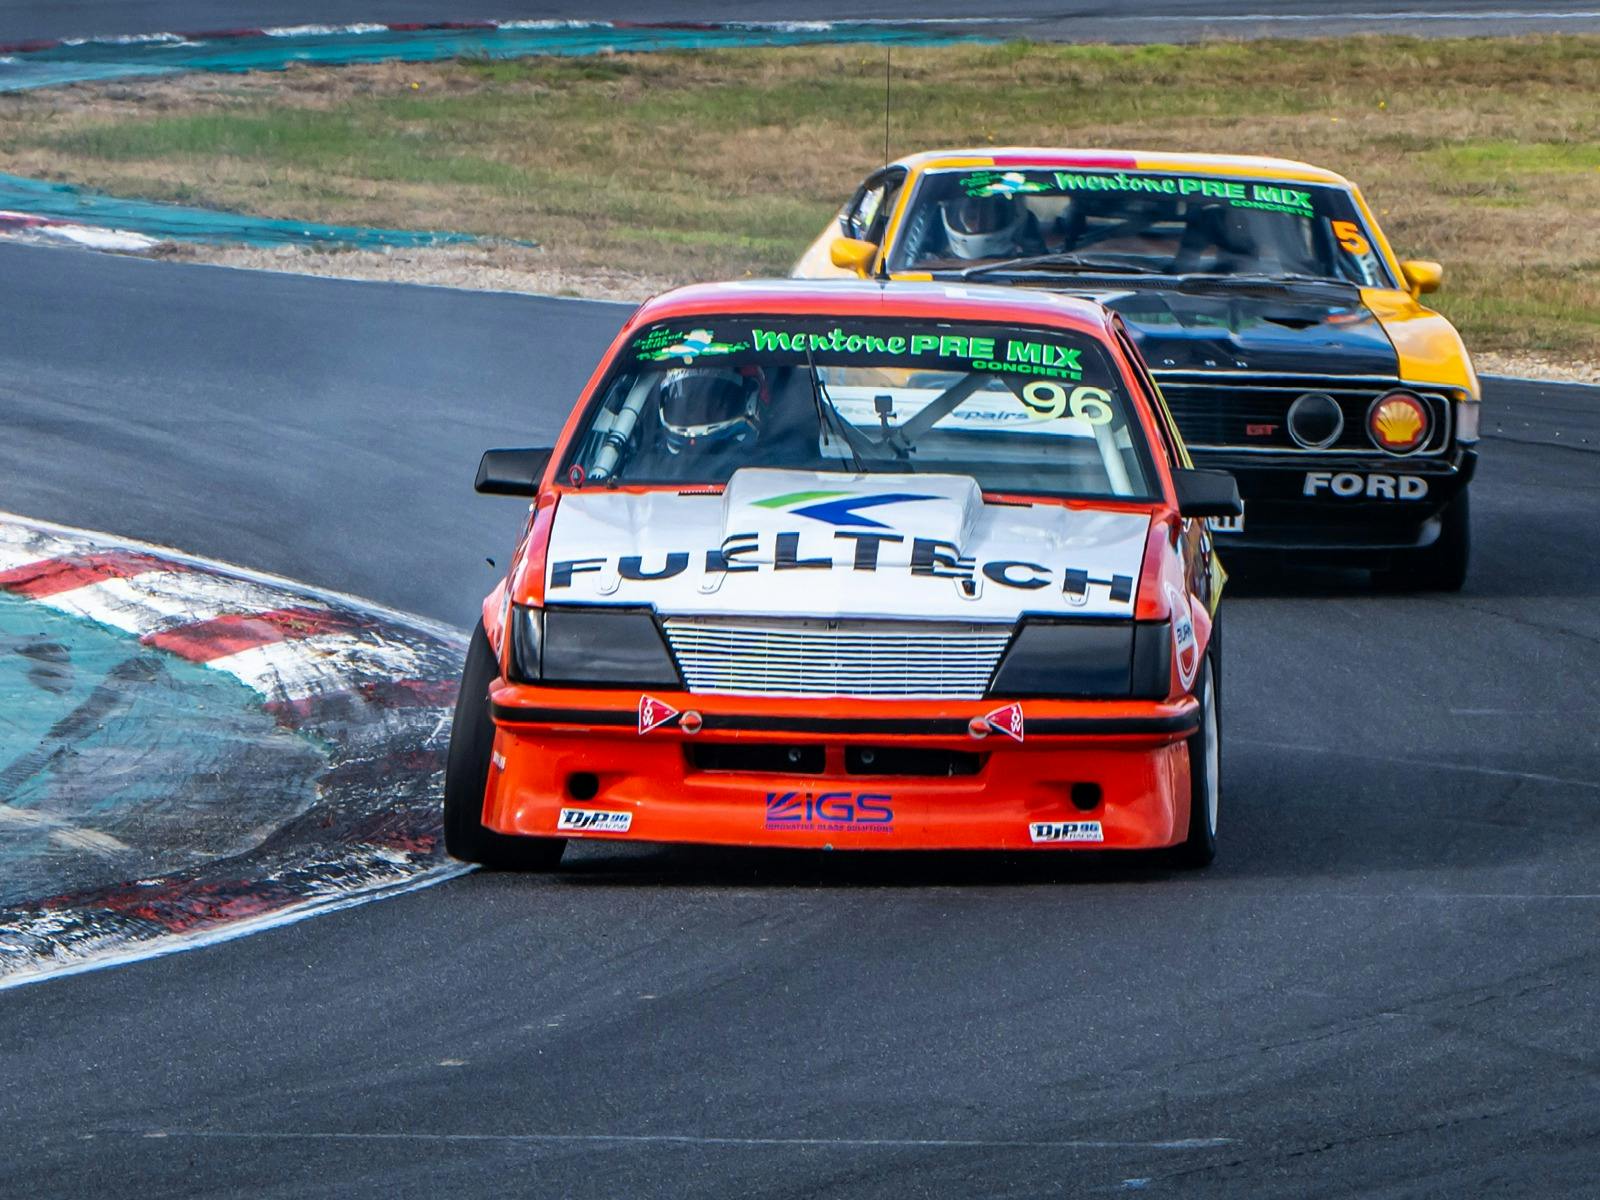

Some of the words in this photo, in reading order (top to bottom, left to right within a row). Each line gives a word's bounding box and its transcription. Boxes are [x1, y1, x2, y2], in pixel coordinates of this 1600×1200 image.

[1178, 177, 1246, 199] PRE
[1254, 184, 1314, 210] MIX
[1230, 198, 1314, 219] CONCRETE
[1331, 220, 1370, 255] 5
[910, 334, 995, 360] PRE
[1006, 339, 1083, 371] MIX
[972, 359, 1083, 381] CONCRETE
[953, 409, 1029, 421] epairs
[1022, 381, 1113, 426] 96
[1303, 471, 1429, 500] FORD
[549, 531, 1134, 603] FUELTECH
